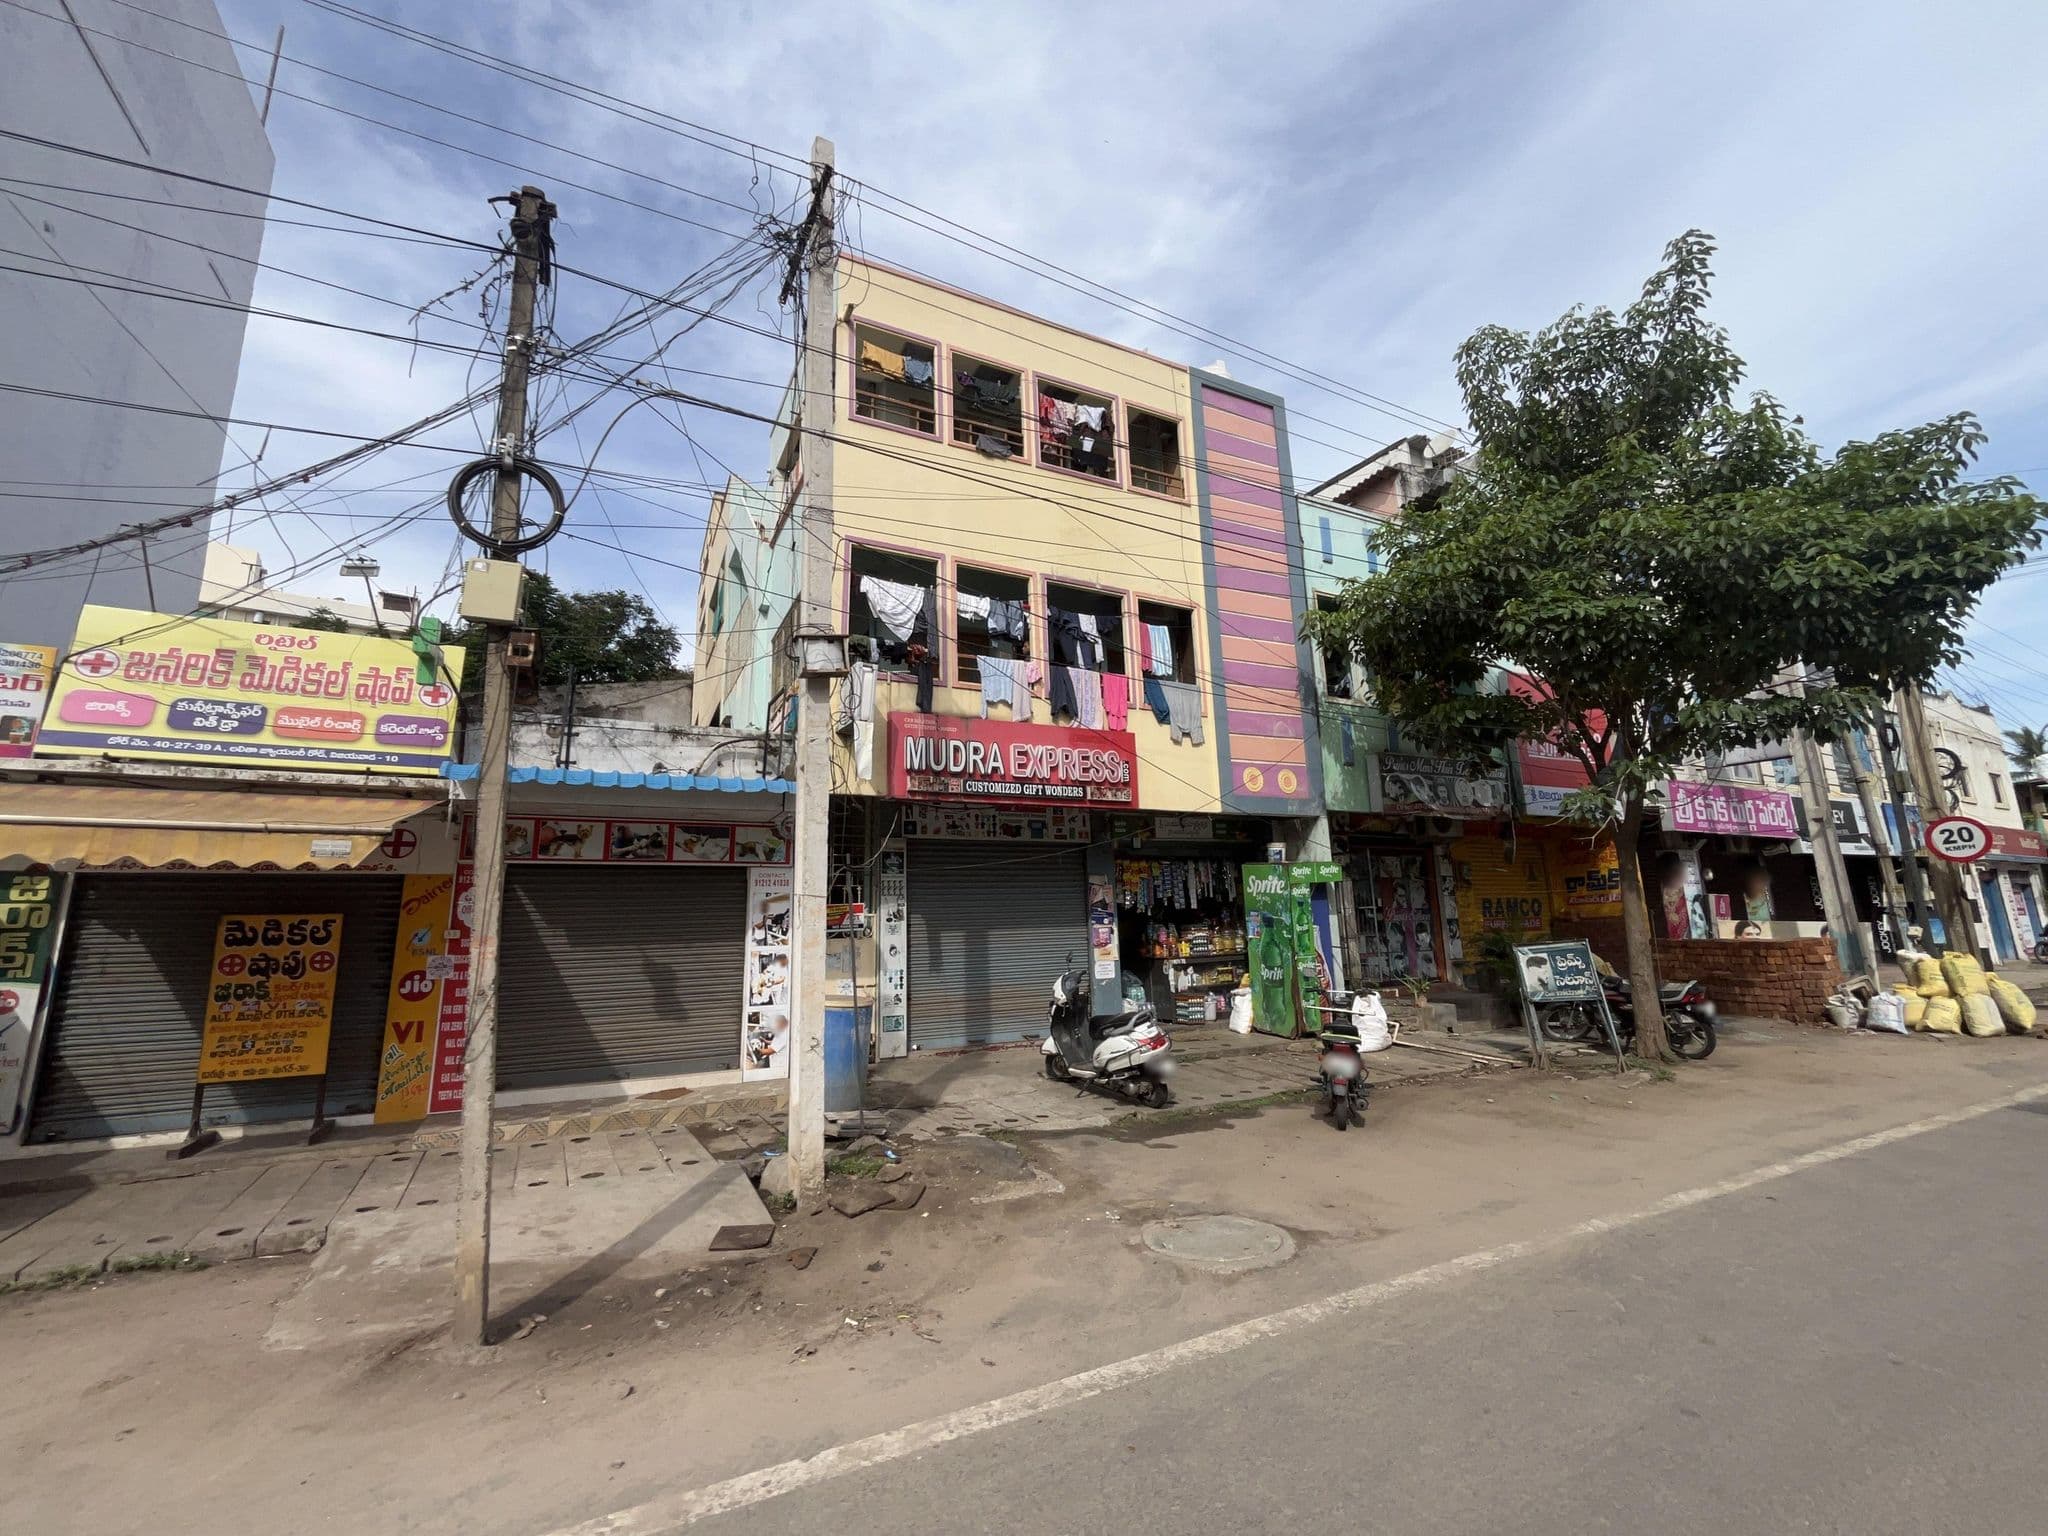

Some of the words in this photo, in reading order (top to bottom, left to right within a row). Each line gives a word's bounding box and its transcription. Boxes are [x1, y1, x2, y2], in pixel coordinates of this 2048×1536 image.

[255, 633, 320, 653] రిటైల్
[239, 655, 353, 699] మెడికల్
[355, 667, 414, 707] షాప్
[152, 740, 211, 751] 40-27-39
[905, 735, 1004, 776] MUDRA
[1009, 743, 1121, 784] EXPRESS
[966, 780, 1022, 795] CUSTOMIZED
[1023, 784, 1044, 796] GIFT
[1044, 786, 1085, 798] WONDERS
[1694, 795, 1729, 822] కనక
[1939, 826, 1974, 845] 20
[1944, 844, 1976, 852] KMPH
[1292, 866, 1312, 876] Sprite
[1320, 864, 1340, 875] Sprite
[1246, 874, 1286, 897] Sprite
[1291, 885, 1311, 897] Sprite
[1482, 897, 1543, 917] RAMCO
[224, 919, 337, 948] మెడికల్
[1877, 920, 1892, 954] JOCKEY
